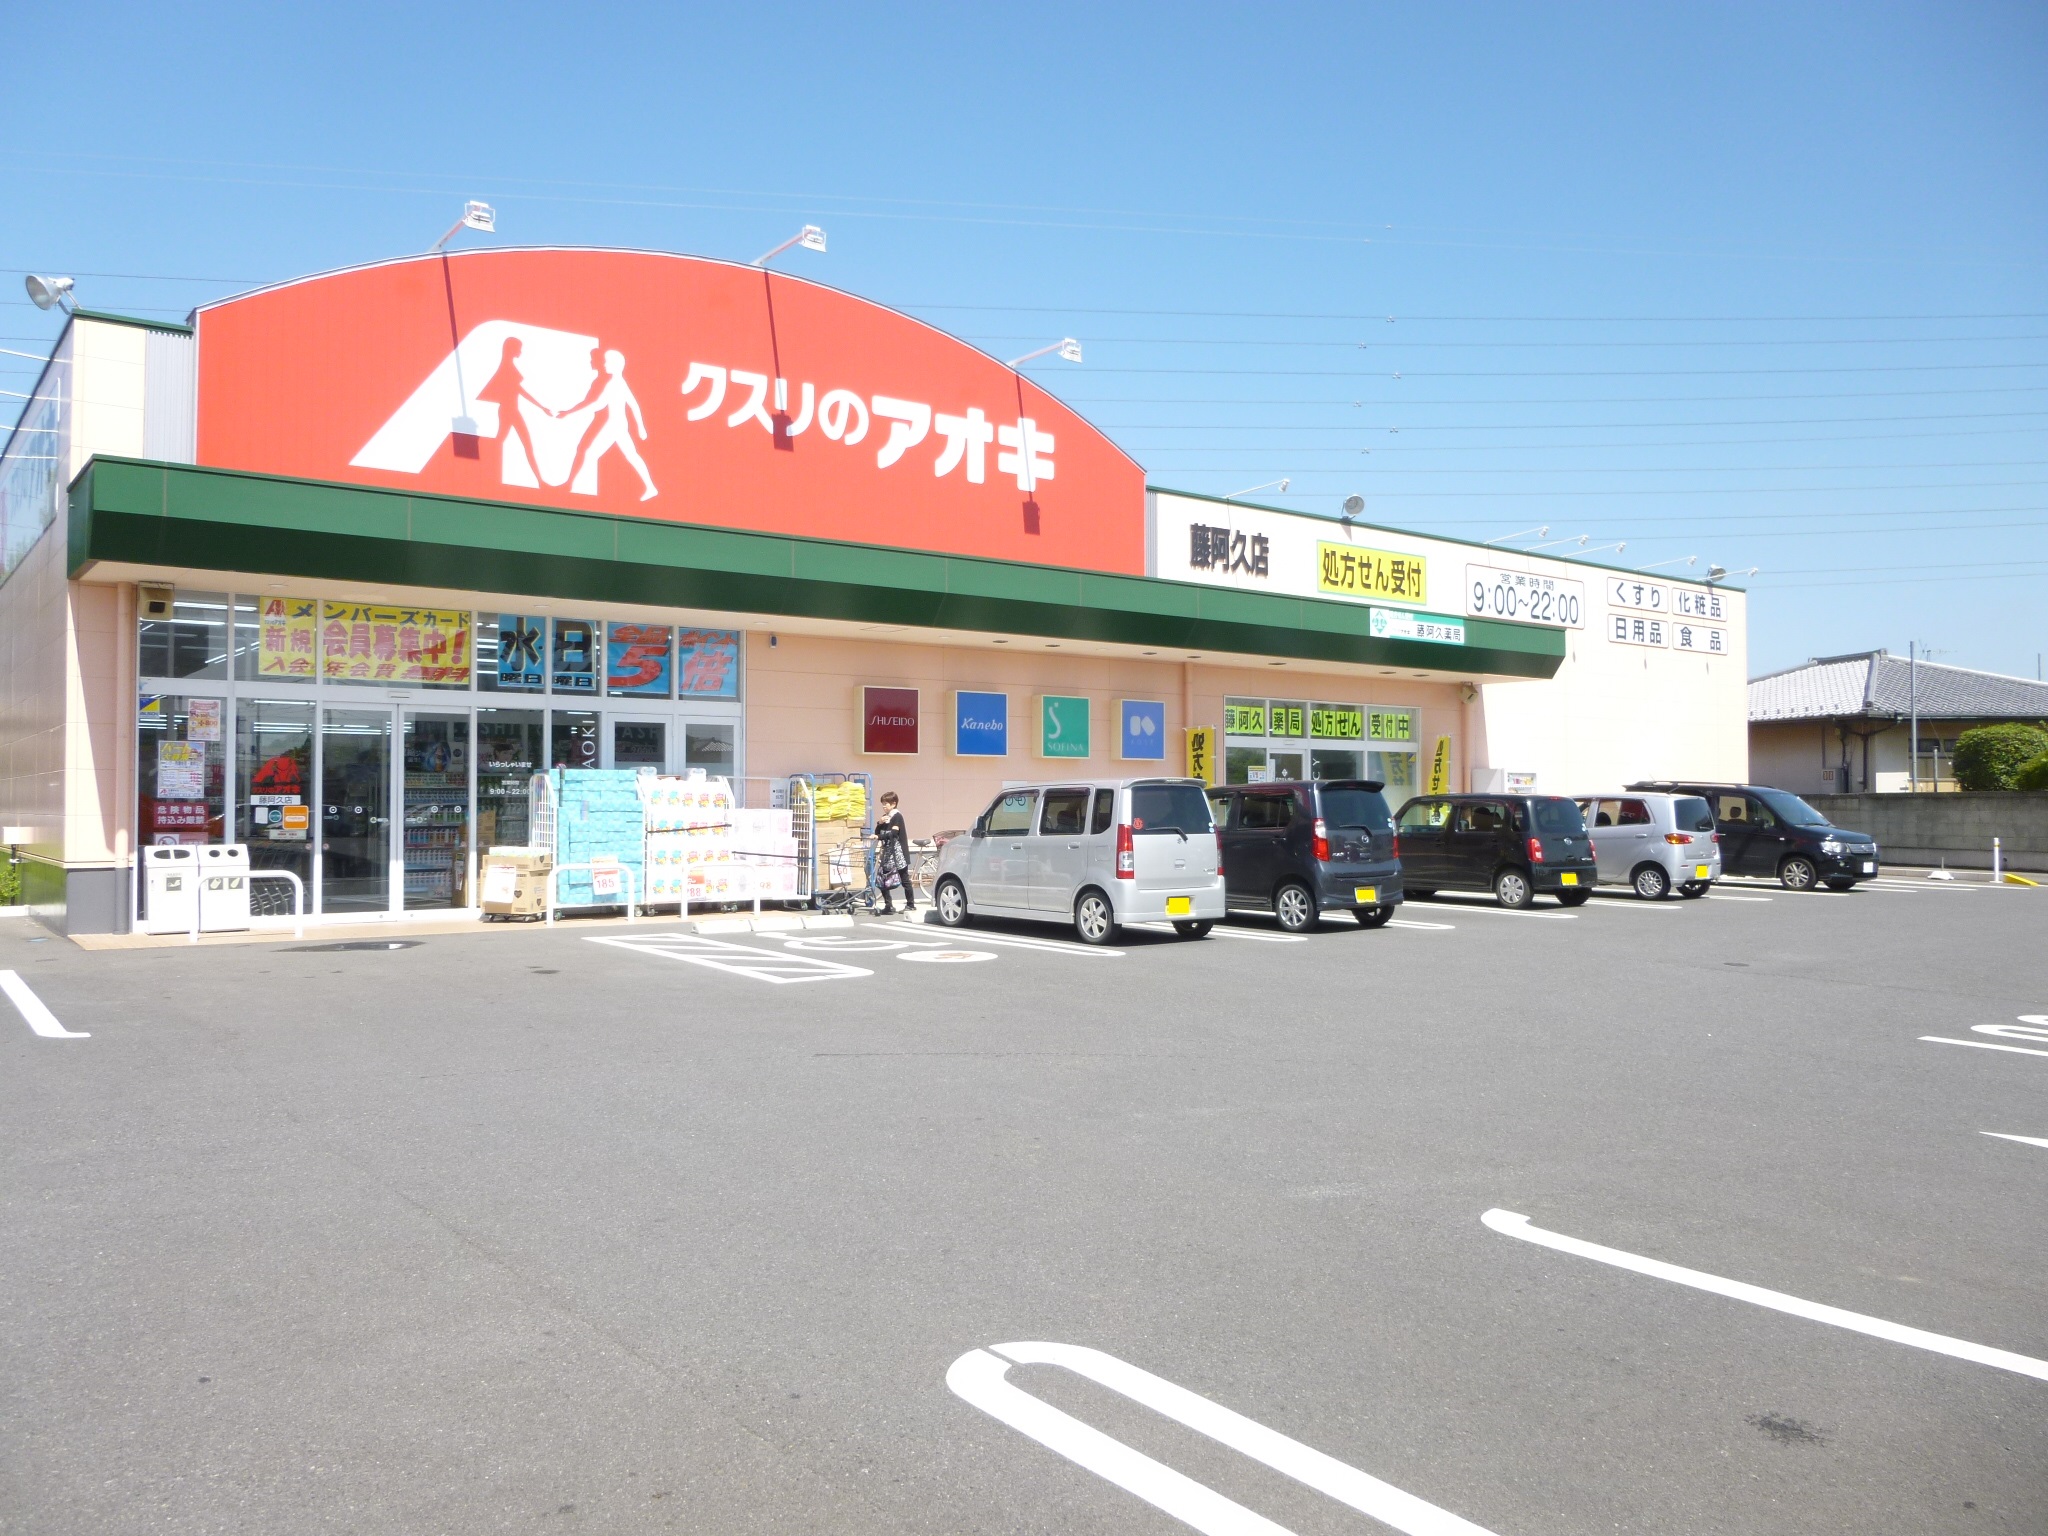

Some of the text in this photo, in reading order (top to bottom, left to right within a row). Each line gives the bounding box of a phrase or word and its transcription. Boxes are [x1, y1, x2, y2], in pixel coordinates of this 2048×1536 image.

[682, 361, 1054, 492] クスリのアオキ
[1190, 523, 1269, 577] 藤阿久店
[1322, 548, 1421, 598] 処方せん受付
[1500, 573, 1554, 591] 営業時間
[1615, 582, 1661, 608] くすり
[1678, 591, 1722, 618] 化粧品
[292, 603, 469, 628] メンバーズカード
[609, 625, 670, 645] 全品
[1417, 624, 1460, 641] 藤阿久薬局
[1615, 617, 1662, 645] 日用品
[1679, 625, 1722, 651] 食品
[681, 651, 733, 691] 倍
[868, 715, 915, 727] SHISEIDO
[961, 717, 1003, 731] Kanebo
[1225, 708, 1409, 736] 藤阿久 薬局 処方せん 受付中
[582, 720, 596, 770] AOKI
[1047, 743, 1084, 752] SOFINA
[488, 760, 533, 768] いらっしゃいませ
[258, 796, 293, 805] 藤阿久店
[596, 878, 615, 889] 185
